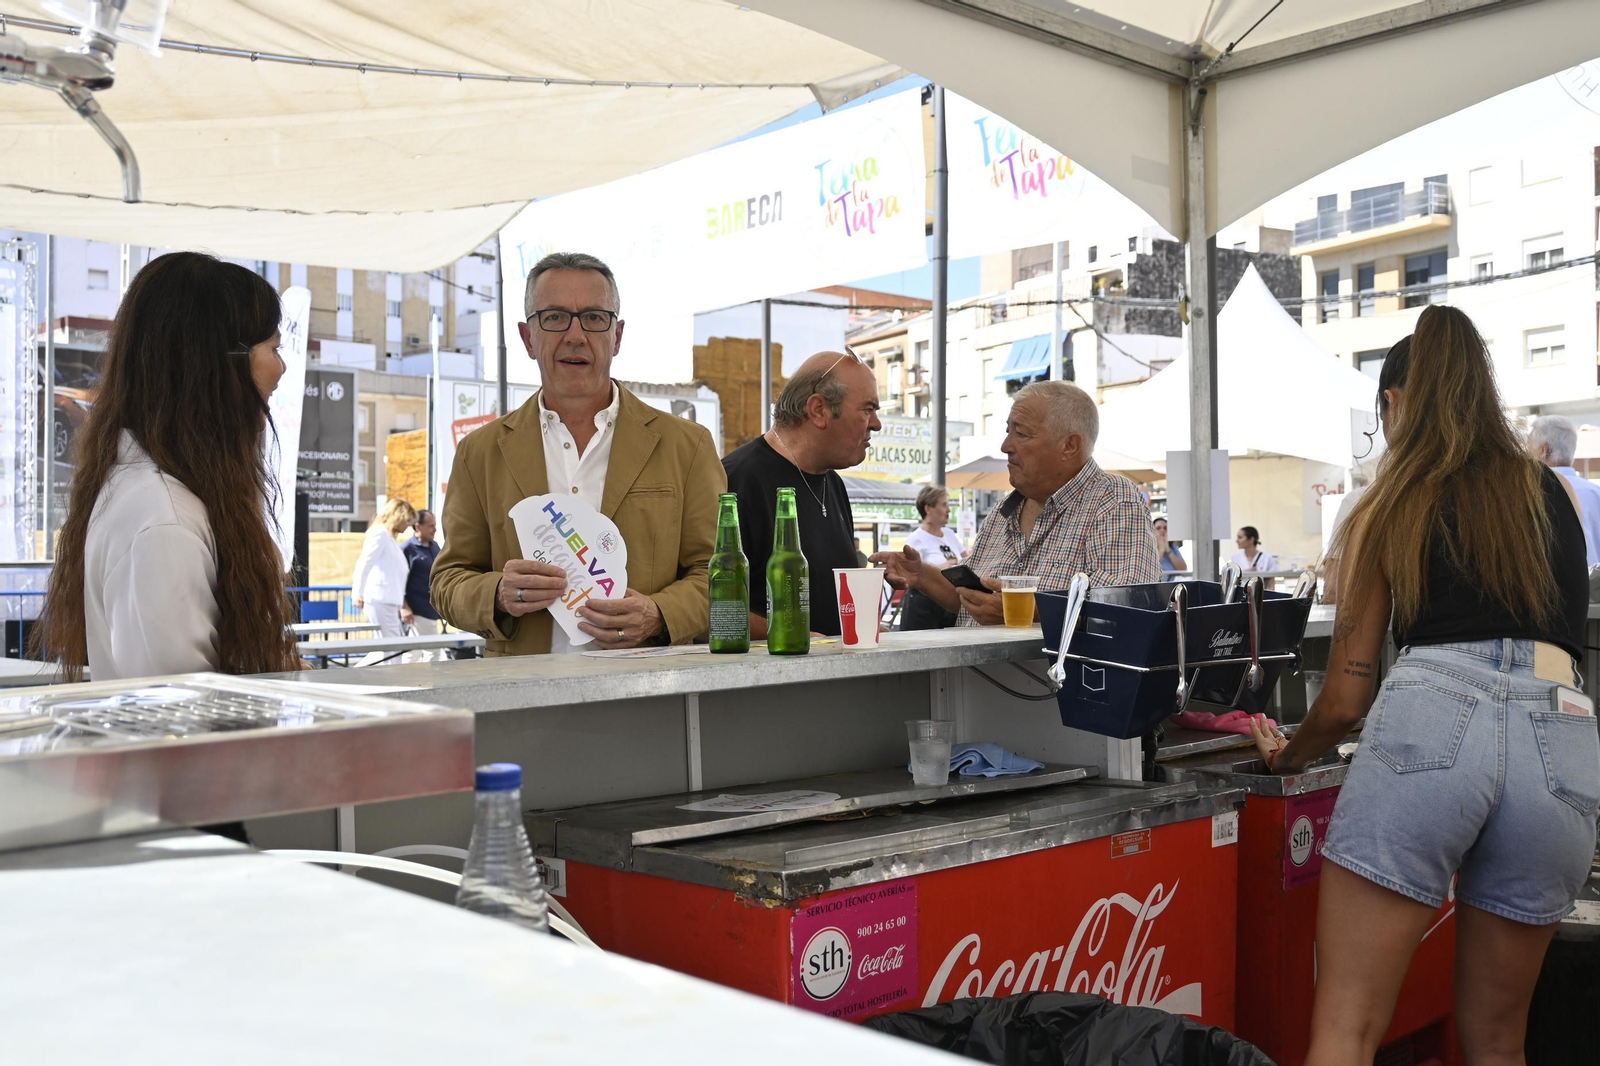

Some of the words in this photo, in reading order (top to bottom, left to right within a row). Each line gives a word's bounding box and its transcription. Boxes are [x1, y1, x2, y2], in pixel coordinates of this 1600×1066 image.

[999, 149, 1075, 201] Tapa
[833, 190, 900, 238] Tapa
[298, 450, 350, 461] NCESIONARIO
[867, 446, 906, 464] PLACAS
[909, 449, 952, 465] SOLAS
[541, 500, 615, 598] HUELVA
[1292, 824, 1310, 849] sth
[806, 901, 843, 918] SERVICIO
[845, 891, 876, 908] TÉCNICO
[878, 883, 906, 899] AVERÍAS
[857, 925, 872, 938] 900
[874, 921, 884, 934] 24
[885, 918, 895, 930] 65
[896, 915, 906, 927] 00
[809, 940, 844, 976] sth
[857, 943, 906, 980] Coca-Cola
[843, 1000, 866, 1015] TOTAL
[868, 986, 908, 1007] HOSTELERÍA
